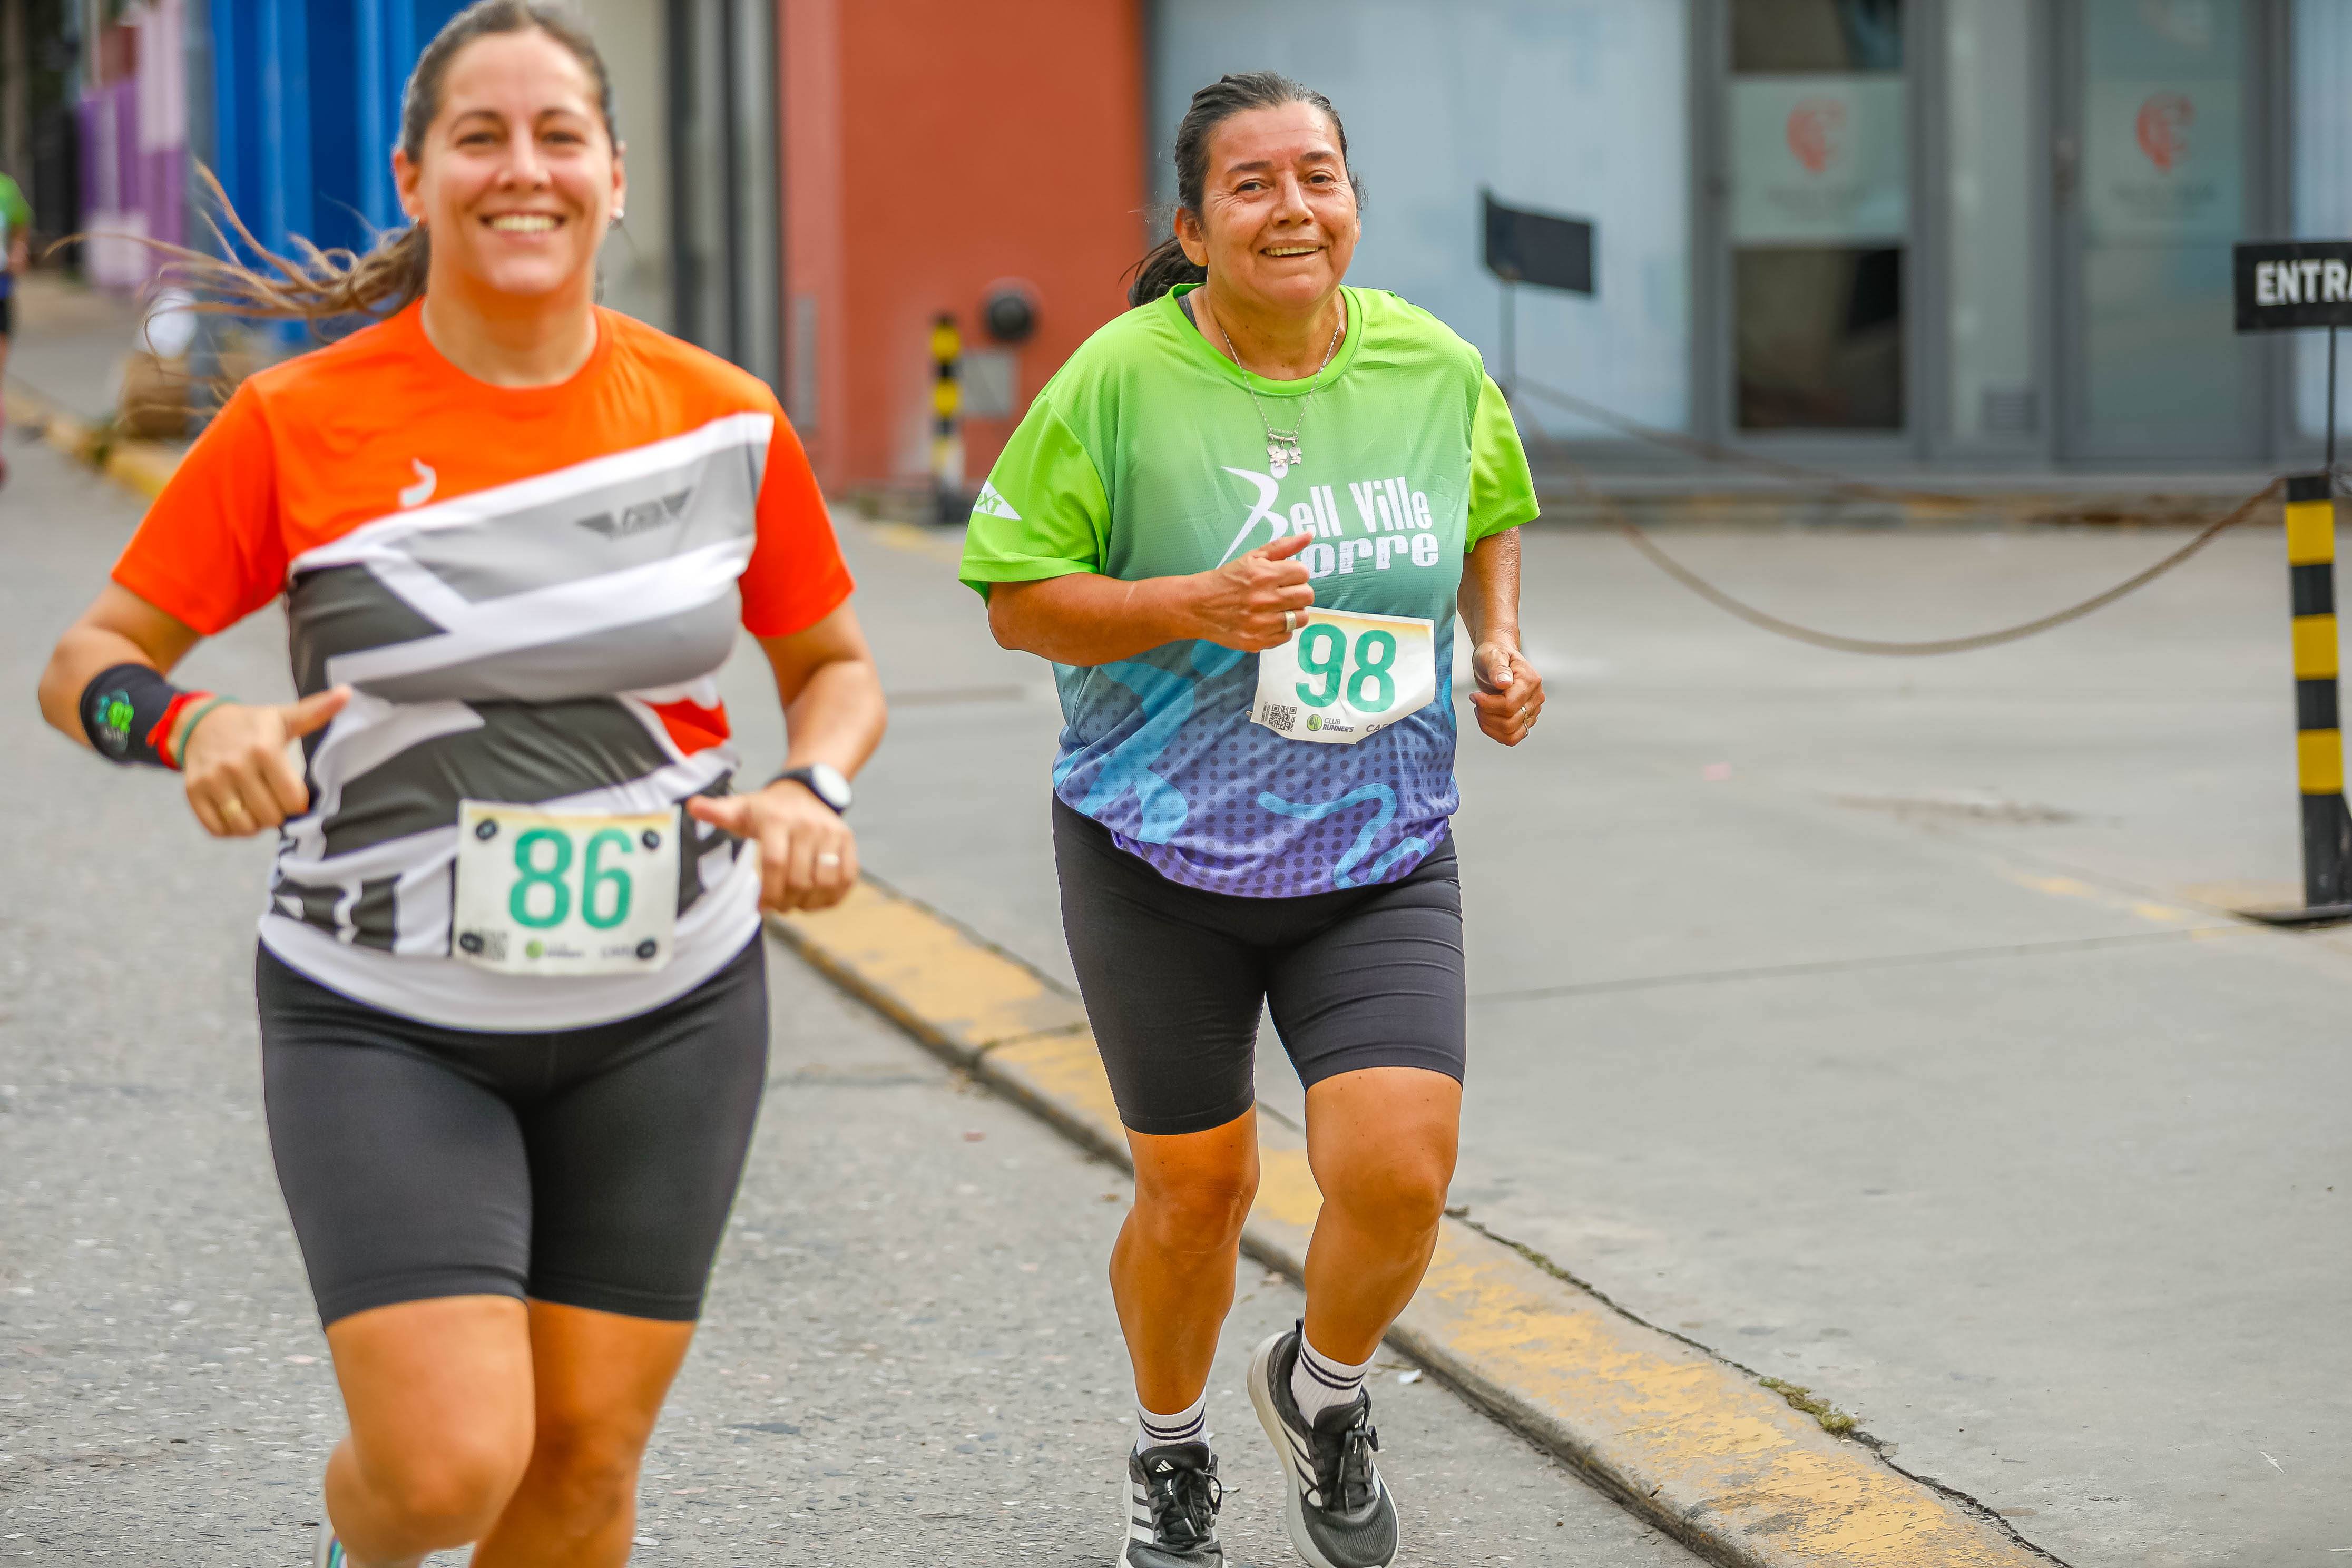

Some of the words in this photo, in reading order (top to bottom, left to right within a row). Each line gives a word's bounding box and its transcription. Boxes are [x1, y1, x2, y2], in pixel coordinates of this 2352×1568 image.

[2255, 258, 2352, 307] ENTR
[1349, 476, 1433, 533] Ville
[1286, 533, 1439, 580] orre
[1295, 623, 1397, 713] 98
[1322, 724, 1355, 733] RUNNER'S
[508, 827, 634, 929] 86
